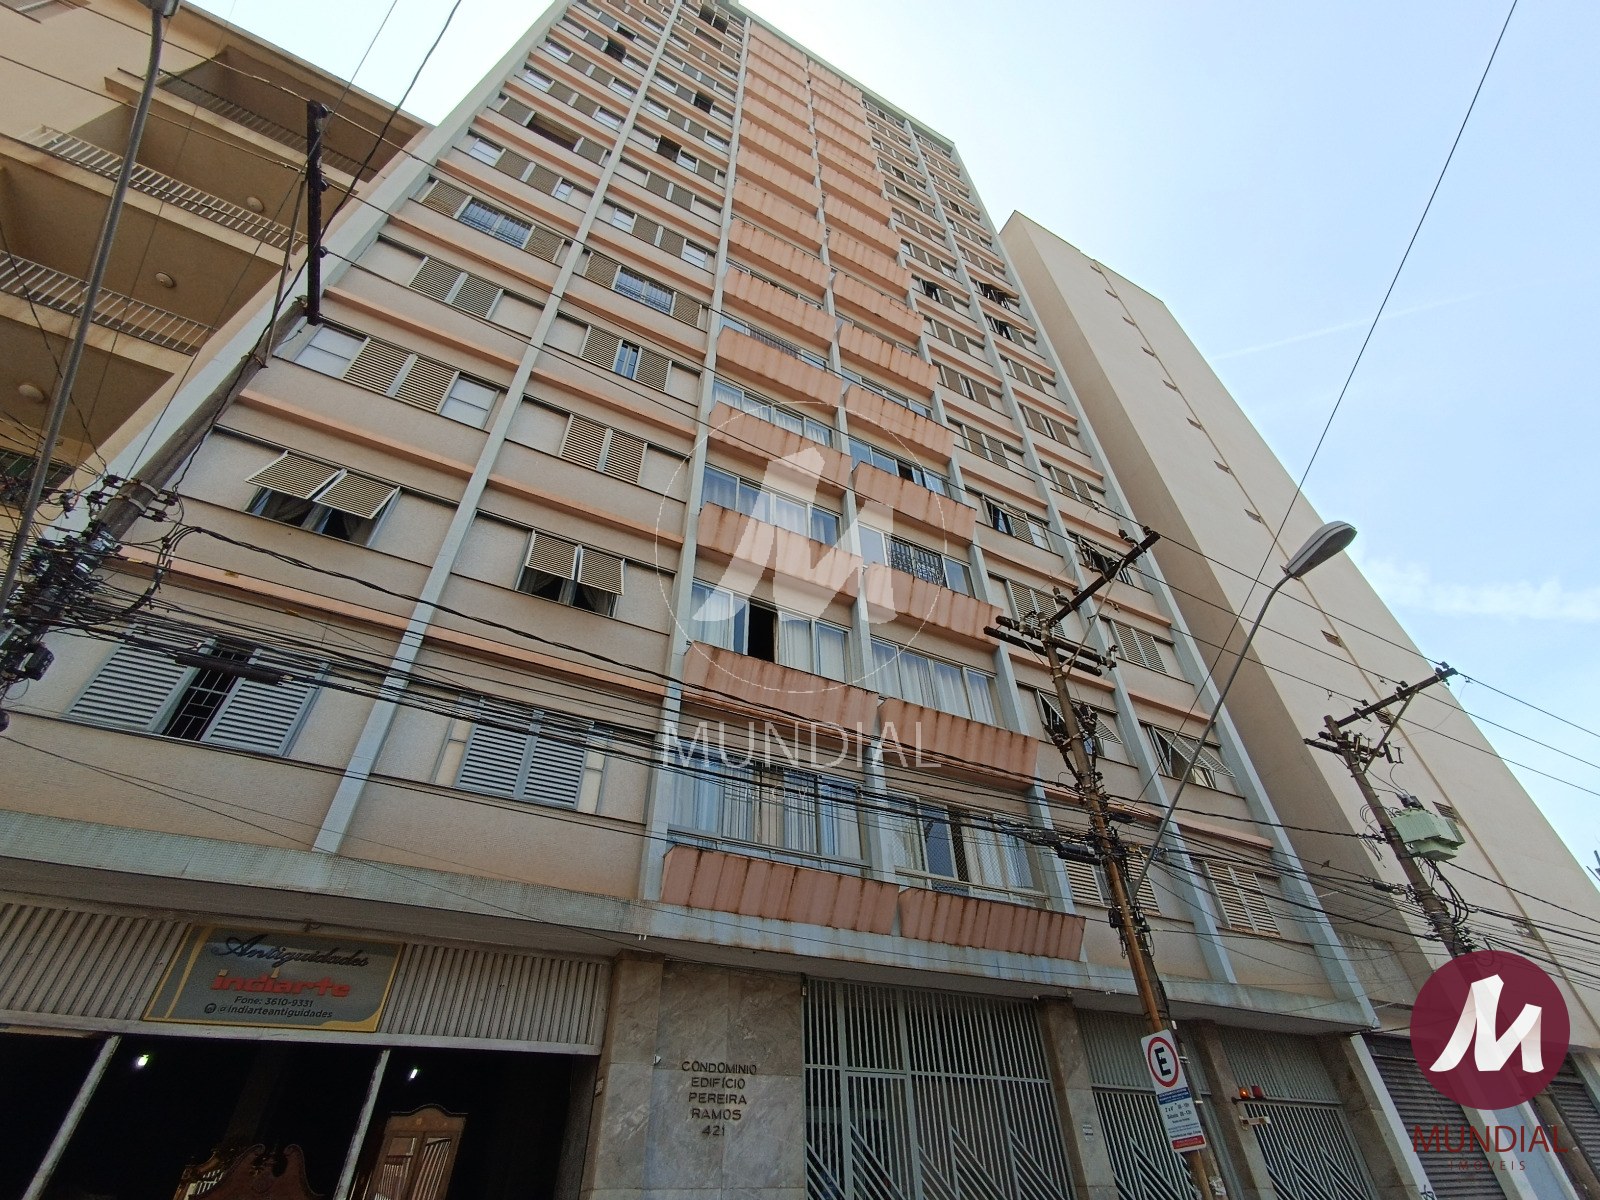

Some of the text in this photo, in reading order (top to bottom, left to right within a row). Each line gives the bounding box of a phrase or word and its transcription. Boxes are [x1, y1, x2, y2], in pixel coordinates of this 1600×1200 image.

[210, 934, 369, 968] Antiguidades
[210, 968, 351, 998] indiarte
[233, 996, 314, 1008] Fone: 3610-9331
[681, 1061, 757, 1075] CONDOMINIO
[1154, 1046, 1172, 1077] E
[688, 1092, 748, 1105] PEREIRA
[691, 1108, 742, 1121] RAMOS
[701, 1125, 726, 1137] 421
